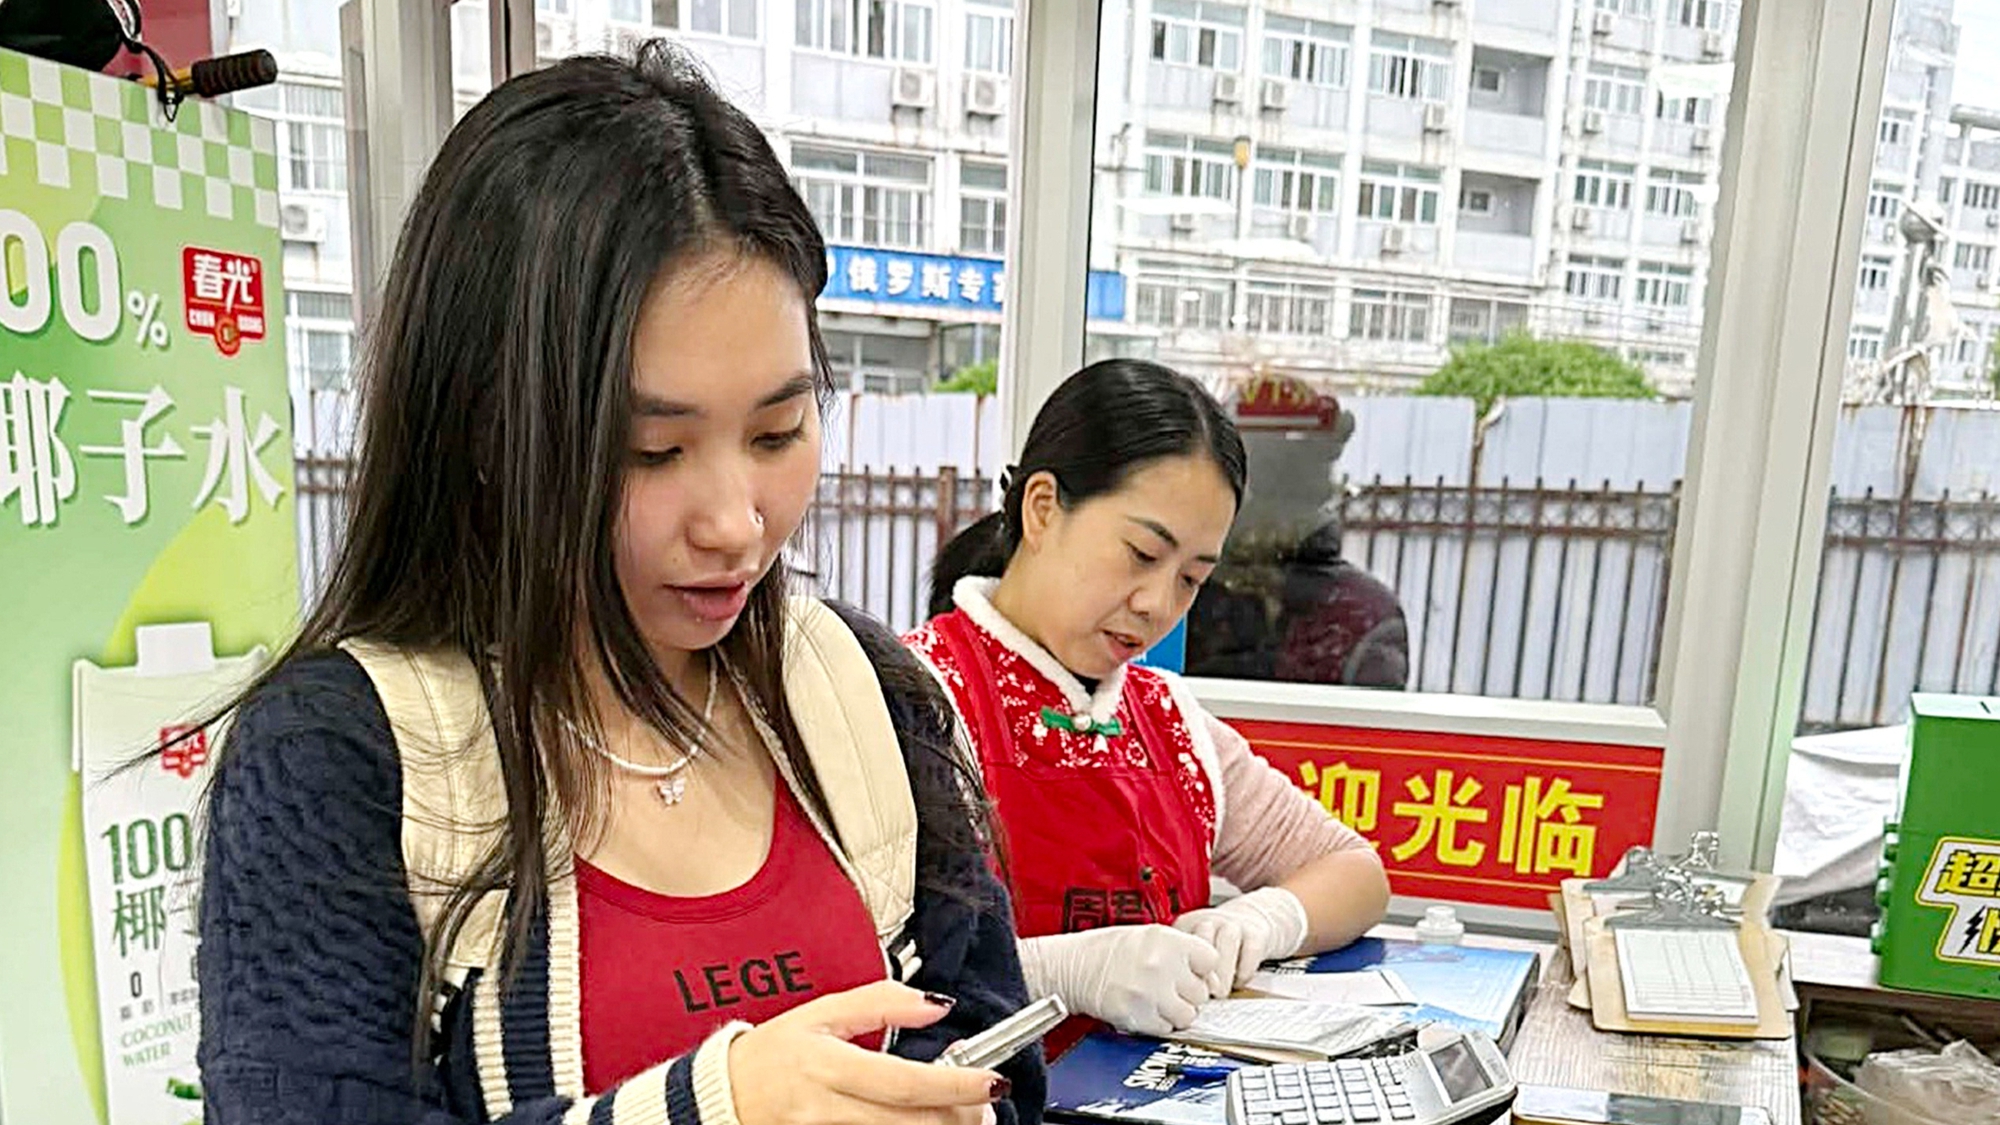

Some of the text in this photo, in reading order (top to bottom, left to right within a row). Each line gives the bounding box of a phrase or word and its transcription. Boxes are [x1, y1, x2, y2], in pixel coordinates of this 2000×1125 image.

[192, 253, 255, 315] 春光
[130, 971, 142, 998] 0
[673, 951, 814, 1013] LEGE
